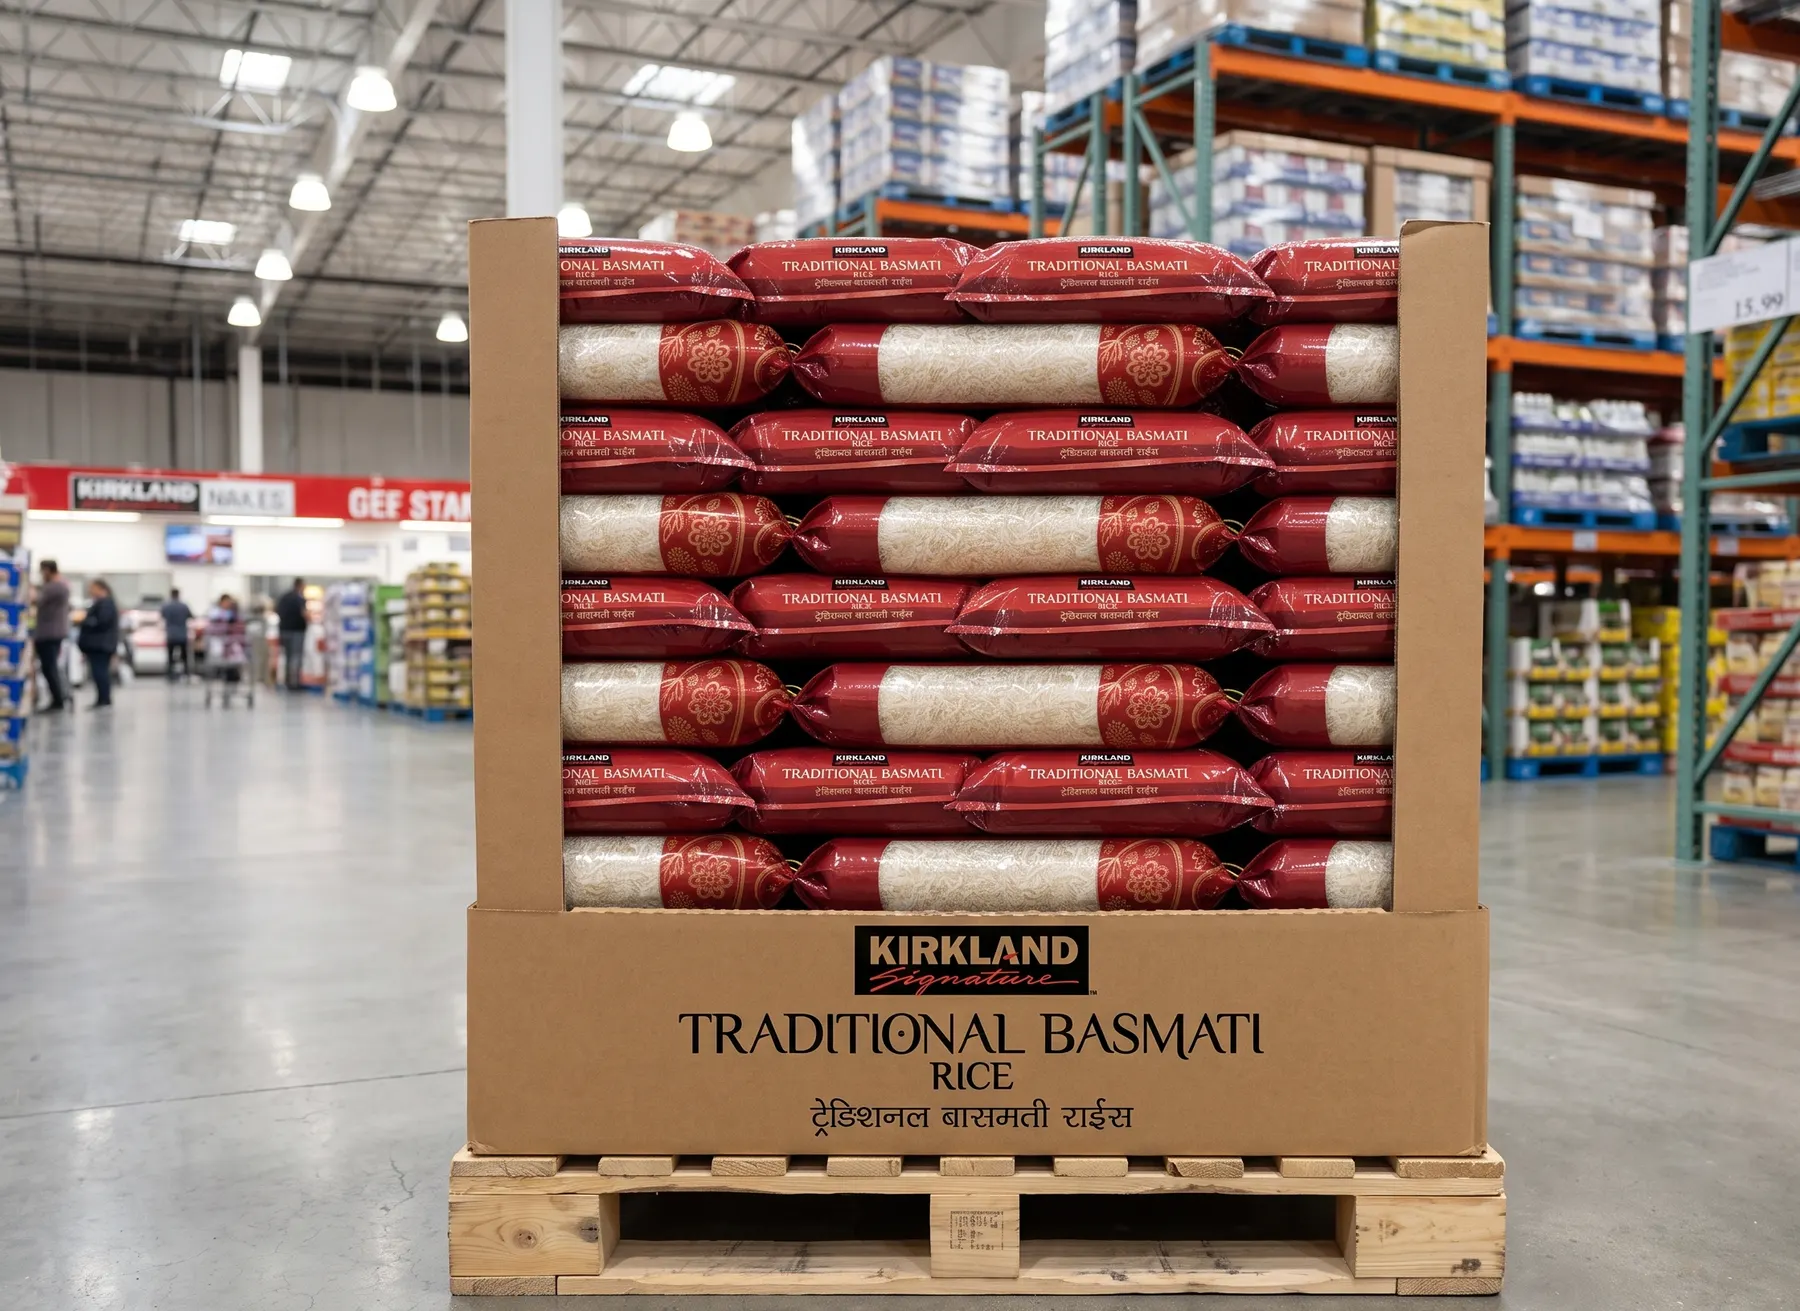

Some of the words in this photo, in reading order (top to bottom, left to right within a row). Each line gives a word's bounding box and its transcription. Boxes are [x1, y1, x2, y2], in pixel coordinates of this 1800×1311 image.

[603, 261, 665, 271] BASMATI
[782, 261, 877, 272] TRADITIONAL
[881, 261, 942, 271] BASMATI
[1027, 260, 1123, 272] TRADITIONAL
[1127, 260, 1188, 271] BASMATI
[1304, 260, 1399, 272] TRADITIONAL
[1734, 292, 1784, 319] 15.99
[604, 430, 666, 441] BASMATI
[782, 430, 877, 441] TRADITIONAL
[881, 430, 942, 441] BASMATI
[1027, 430, 1123, 441] TRADITIONAL
[1127, 430, 1188, 441] BASMATI
[1304, 430, 1397, 441] TRADITIONAL
[76, 479, 197, 503] KIRKLAND
[604, 593, 665, 603] BASMATI
[782, 593, 876, 604] TRADITIONAL
[881, 593, 942, 603] BASMATI
[1028, 593, 1123, 604] TRADITIONAL
[1128, 593, 1188, 603] BASMATI
[604, 768, 666, 779] BASMATI
[782, 769, 877, 779] TRADITIONAL
[882, 769, 944, 779] BASMATI
[1028, 769, 1122, 779] TRADITIONAL
[1128, 768, 1192, 779] BASMATI
[1303, 769, 1394, 780] TRADITIONA
[870, 936, 1079, 965] KIRKLAND
[869, 967, 1079, 995] Signature
[679, 1013, 1025, 1054] TRADITIONAL
[1040, 1013, 1264, 1060] BASMATI
[930, 1062, 1013, 1090] RICE
[941, 1098, 1050, 1128] बासमती
[1061, 1098, 1134, 1130] राईस
